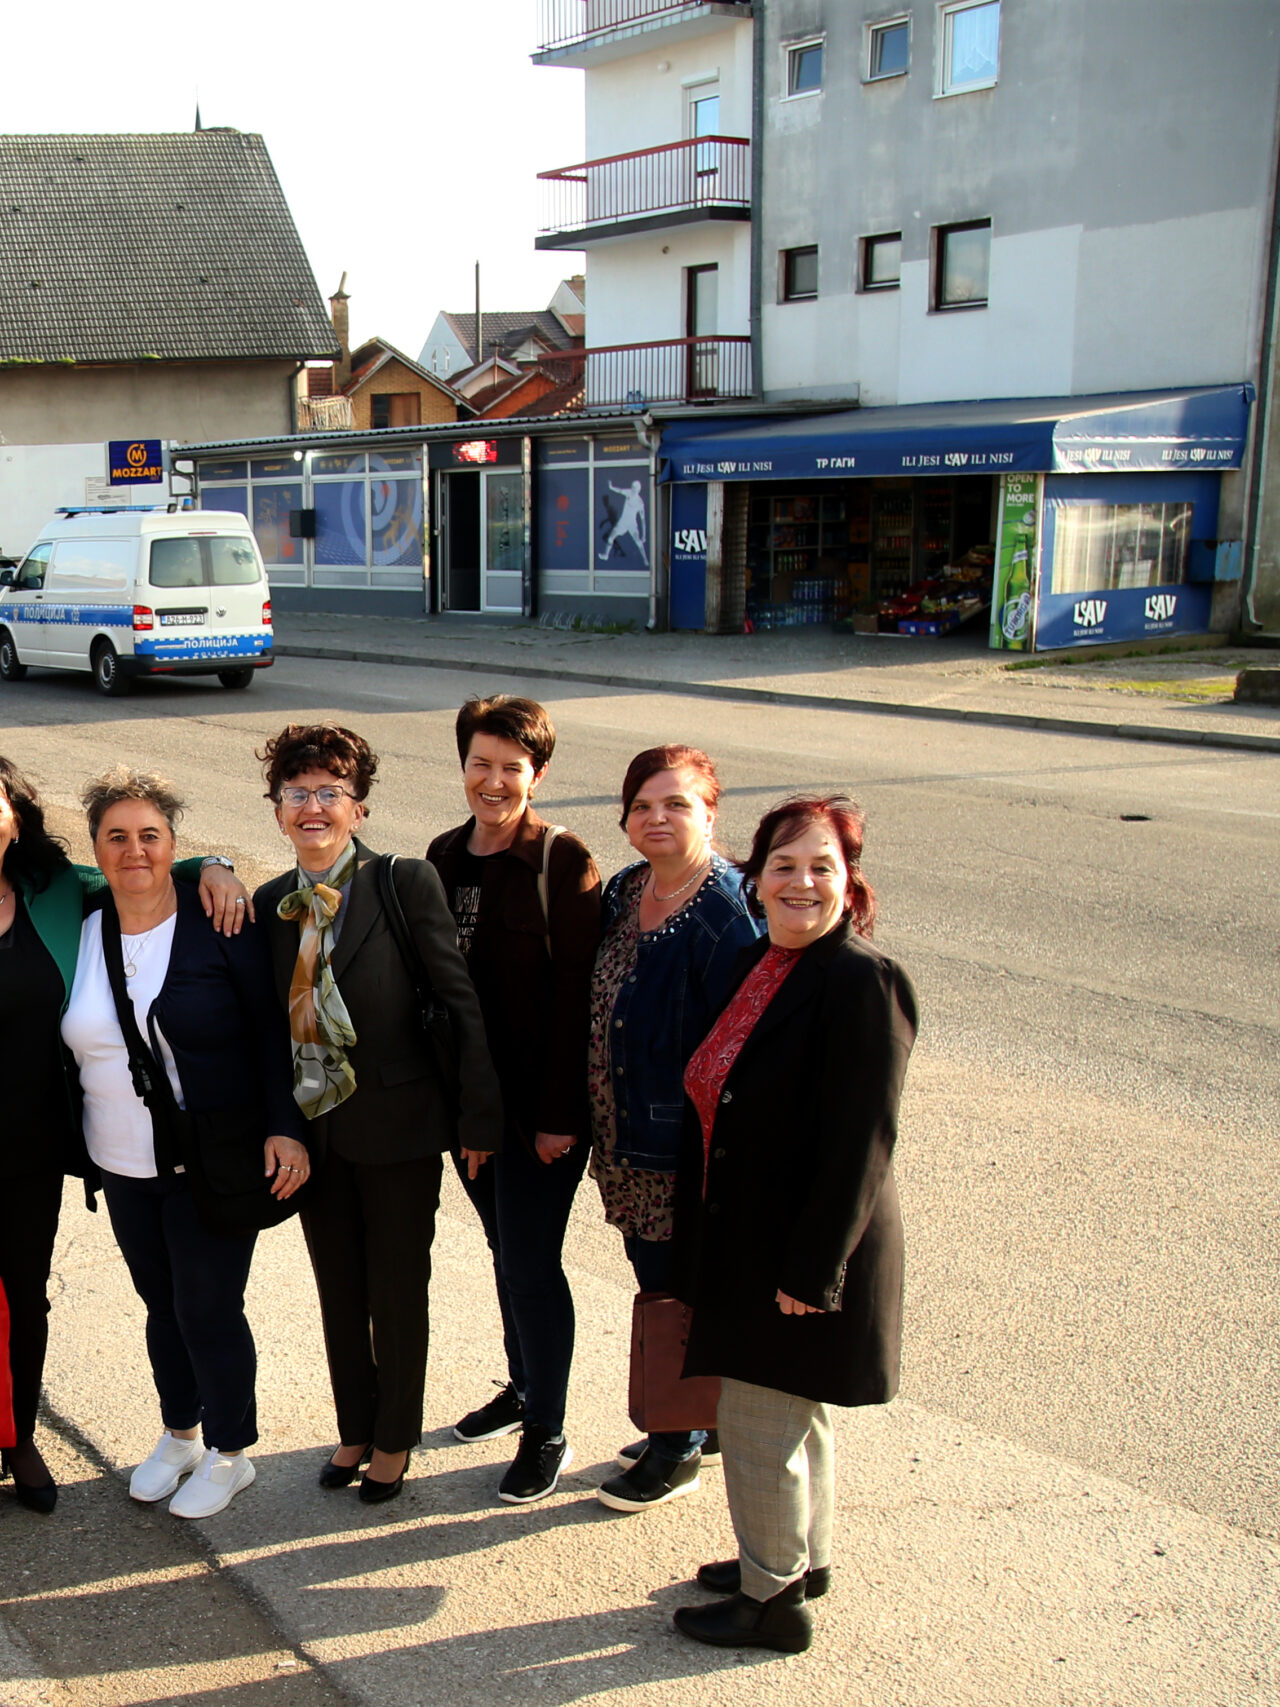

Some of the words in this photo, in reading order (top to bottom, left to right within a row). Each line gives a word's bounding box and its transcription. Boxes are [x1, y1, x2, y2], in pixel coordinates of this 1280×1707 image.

[816, 458, 829, 469] ТР
[830, 457, 855, 468] ГАГИ
[902, 456, 916, 467] ILI
[918, 455, 940, 467] JESI
[971, 454, 986, 465] ILI
[989, 453, 1013, 464] NISI
[112, 466, 162, 478] MOZZART
[683, 464, 695, 474] ILI
[696, 463, 714, 474] JESI
[738, 462, 751, 472] ILI
[753, 461, 772, 472] NISI
[1007, 474, 1034, 483] OPEN
[1007, 483, 1022, 493] TO
[1007, 493, 1034, 503] MORE
[23, 607, 66, 621] ПОЛИЦИЈА
[183, 637, 239, 649] ПОЛИЦИЈА
